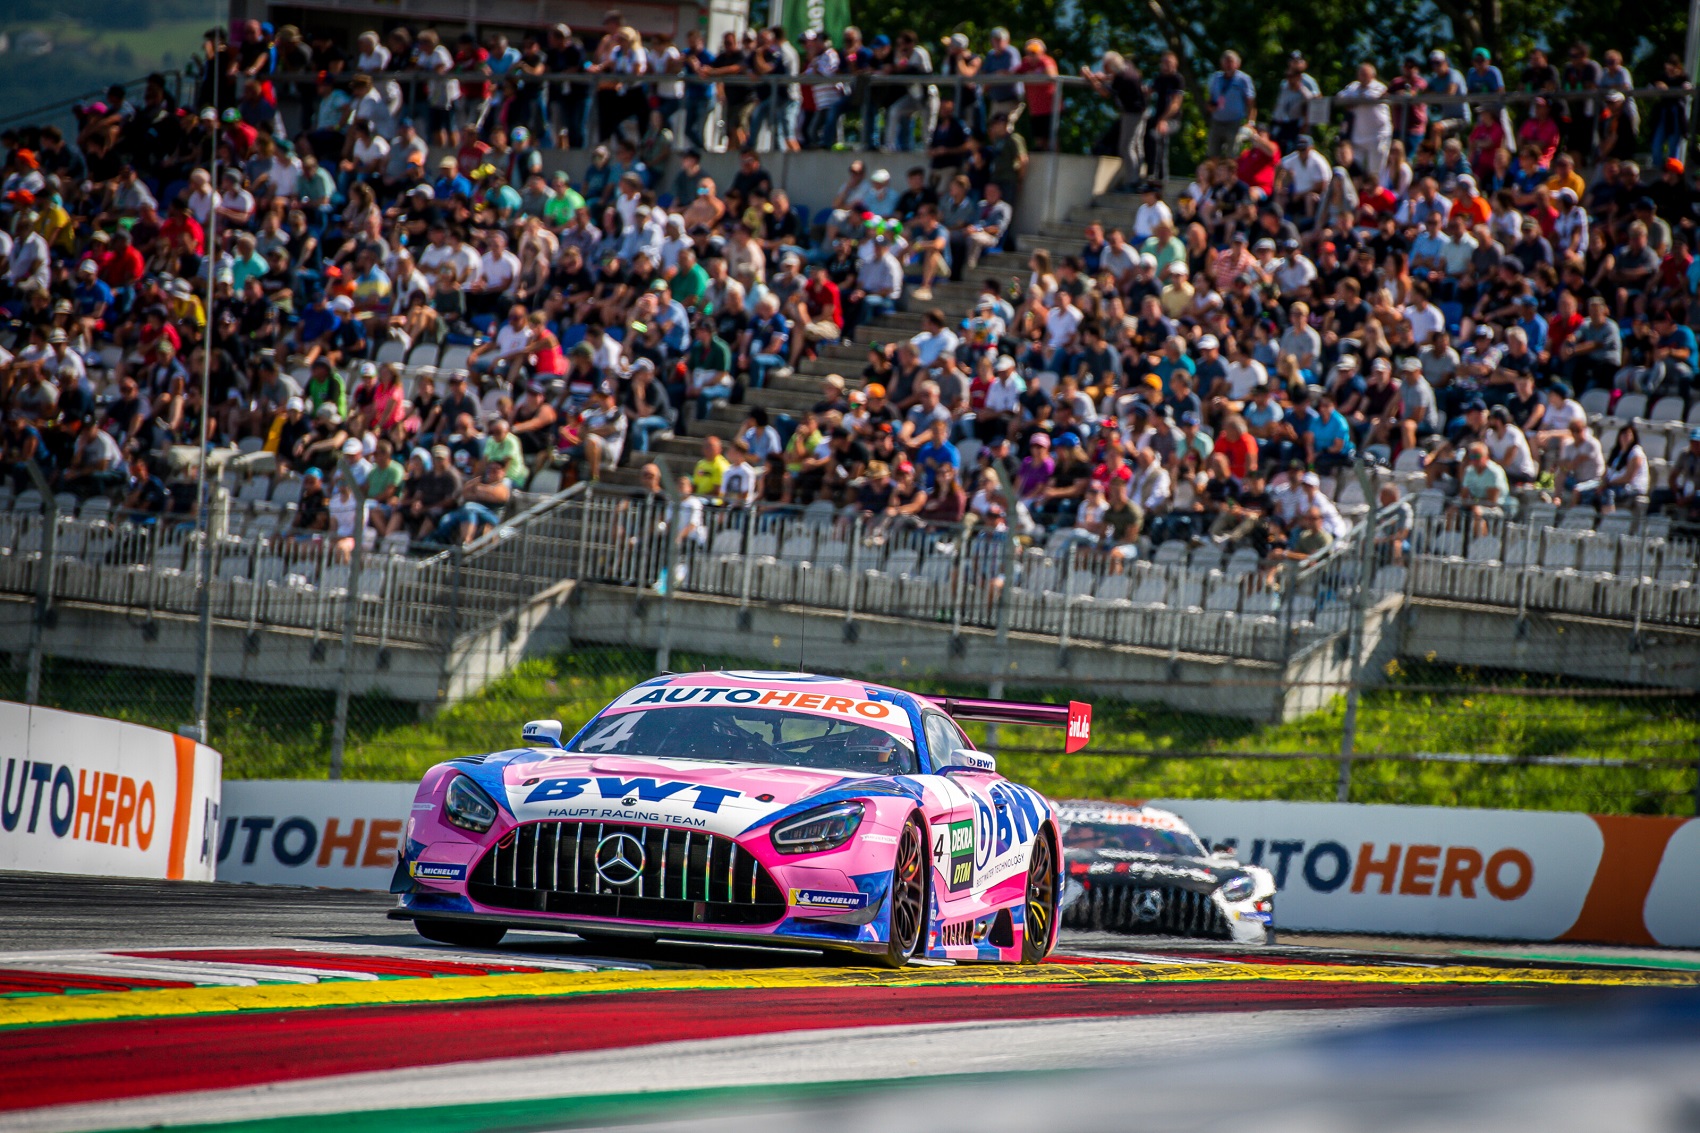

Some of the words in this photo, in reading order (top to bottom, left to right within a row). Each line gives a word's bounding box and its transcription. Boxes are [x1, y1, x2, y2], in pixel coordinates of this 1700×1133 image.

[629, 688, 890, 719] AUTOHERO
[578, 711, 648, 752] 4
[0, 757, 156, 852] UTOHERO
[523, 777, 741, 814] BWT
[548, 808, 598, 818] HAUPT
[601, 809, 659, 822] RACING
[664, 814, 706, 827] TEAM
[933, 833, 945, 863] 4
[951, 825, 973, 853] DEKRA
[423, 867, 456, 876] MICHELIN
[952, 861, 973, 885] DTM
[811, 895, 860, 905] MICHELIN
